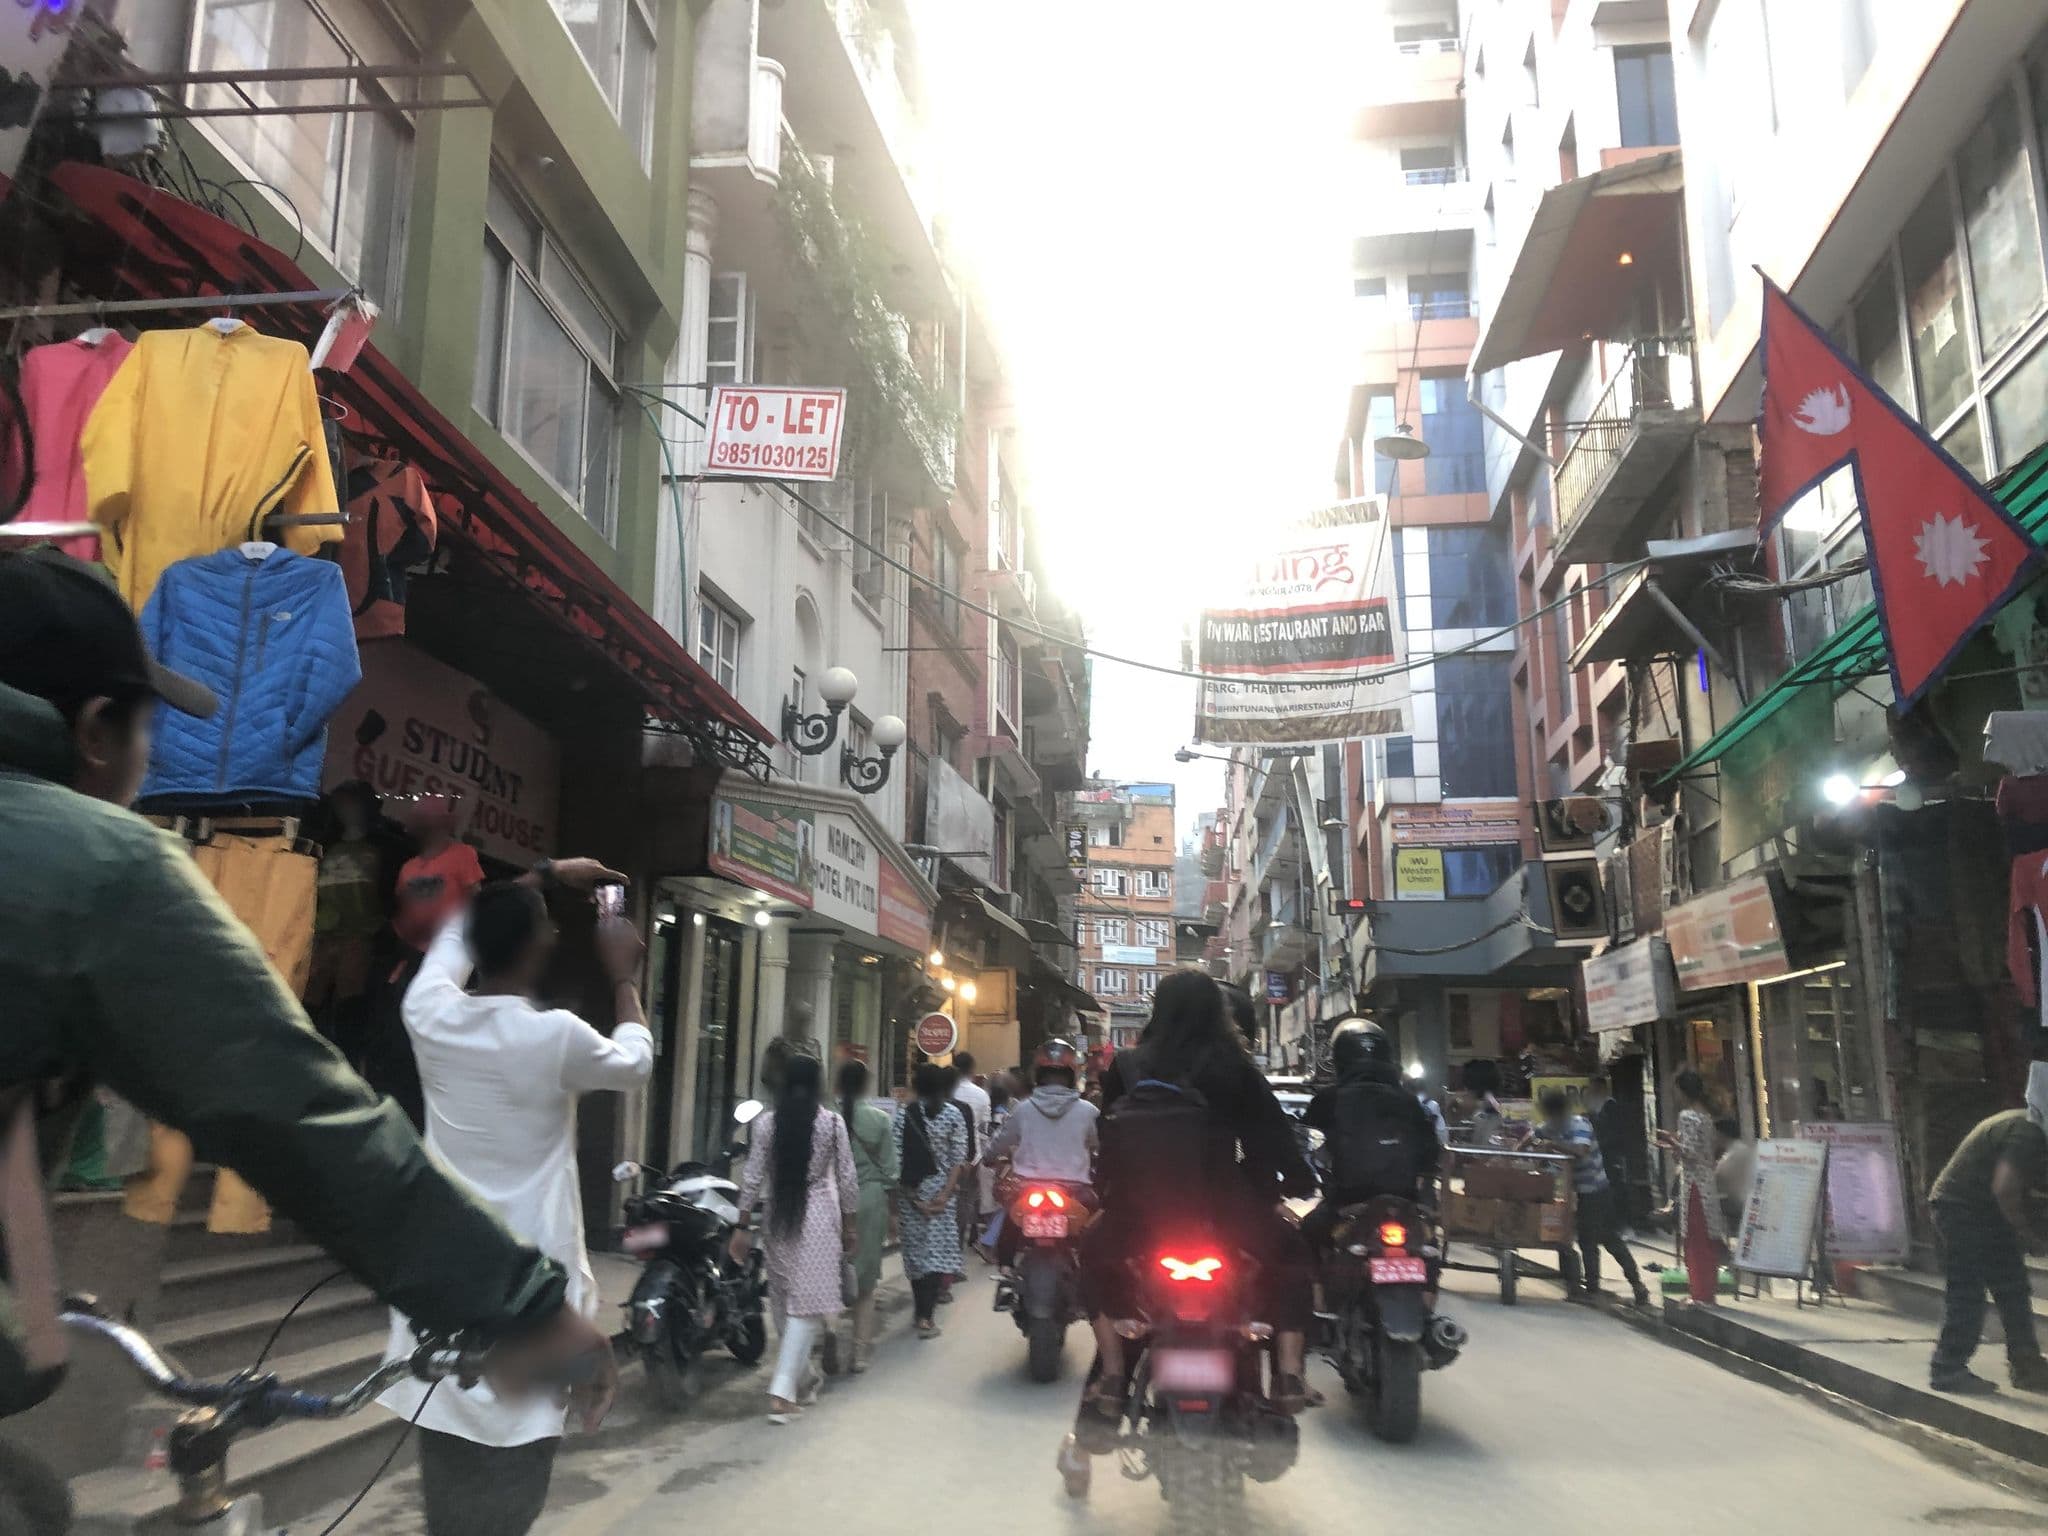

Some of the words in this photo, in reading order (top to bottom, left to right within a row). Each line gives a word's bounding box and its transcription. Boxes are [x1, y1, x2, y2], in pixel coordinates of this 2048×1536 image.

[725, 395, 760, 432] TO
[783, 397, 835, 435] LET
[717, 441, 828, 469] 9851030125
[1332, 614, 1357, 636] AND
[1068, 830, 1082, 858] SPA
